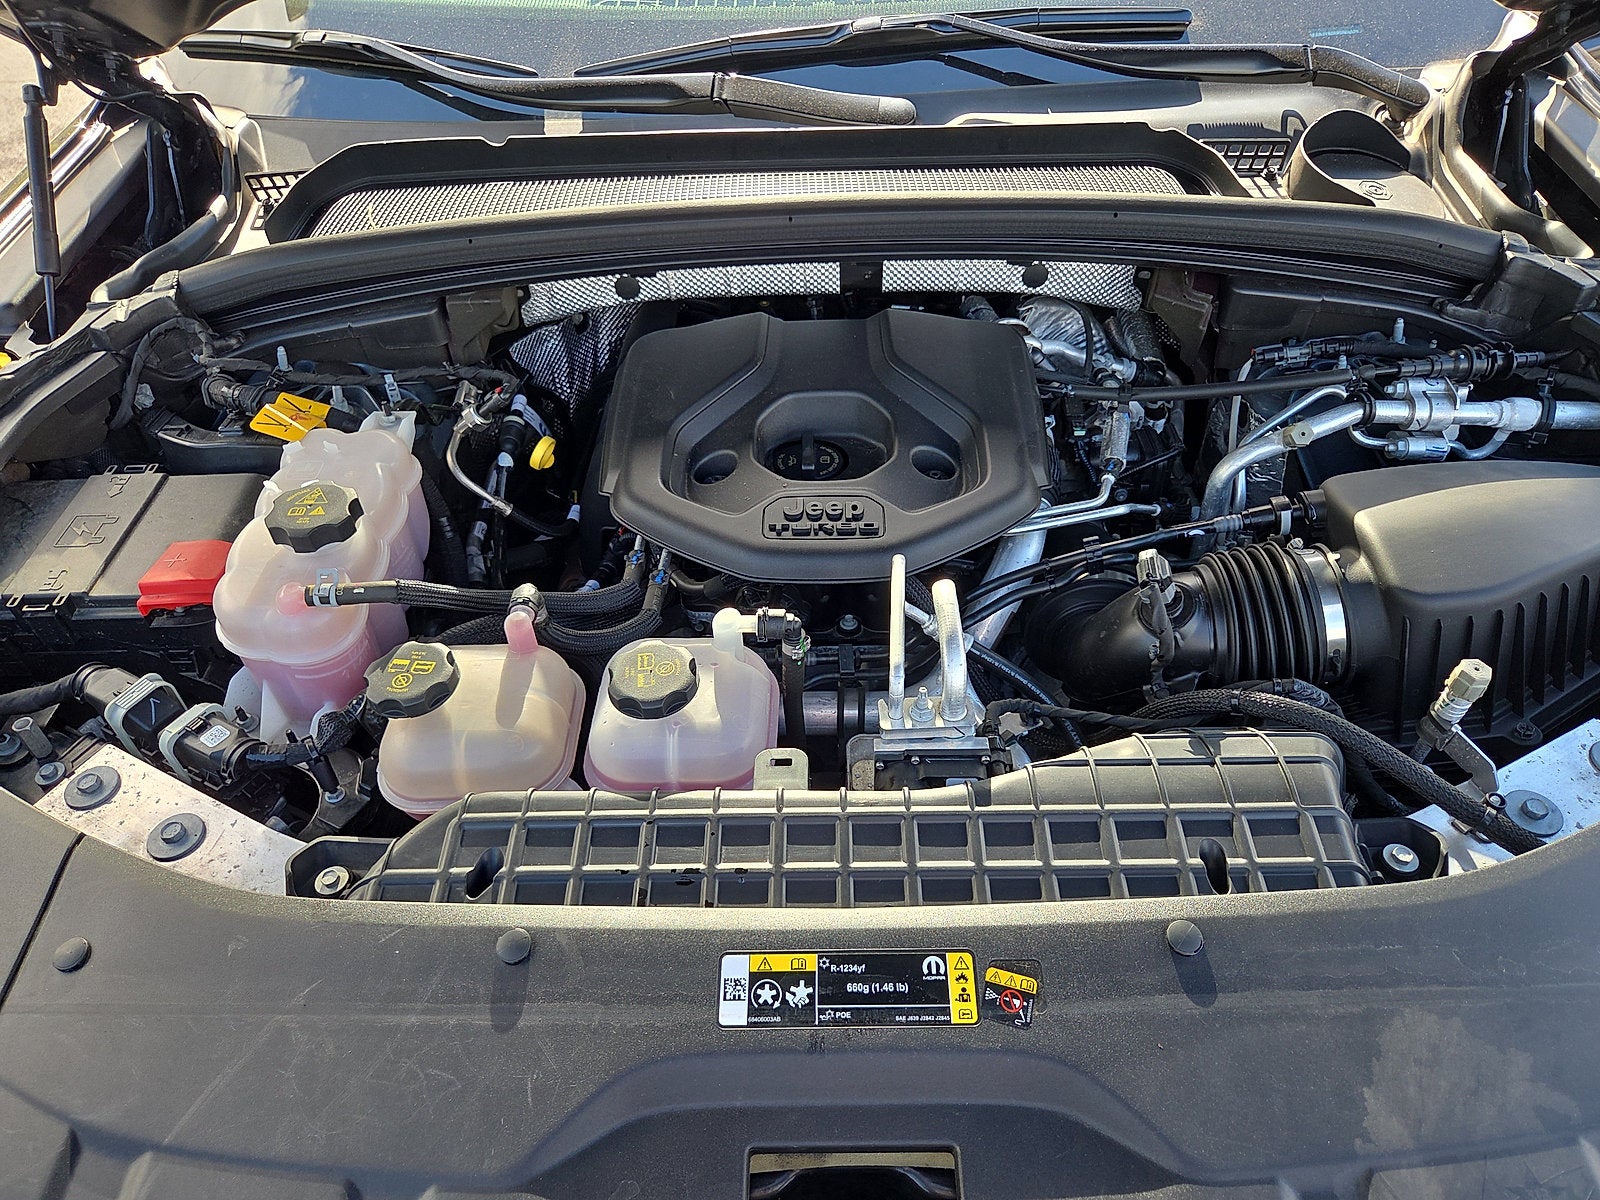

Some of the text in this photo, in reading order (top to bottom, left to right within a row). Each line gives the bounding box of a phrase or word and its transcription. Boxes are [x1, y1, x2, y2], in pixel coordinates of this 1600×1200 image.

[782, 498, 865, 523] Jeep
[768, 522, 880, 537] TURBO
[830, 963, 866, 974] R-1234yf
[846, 982, 909, 993] 660g (1.46 lb)
[835, 1011, 852, 1019] POE
